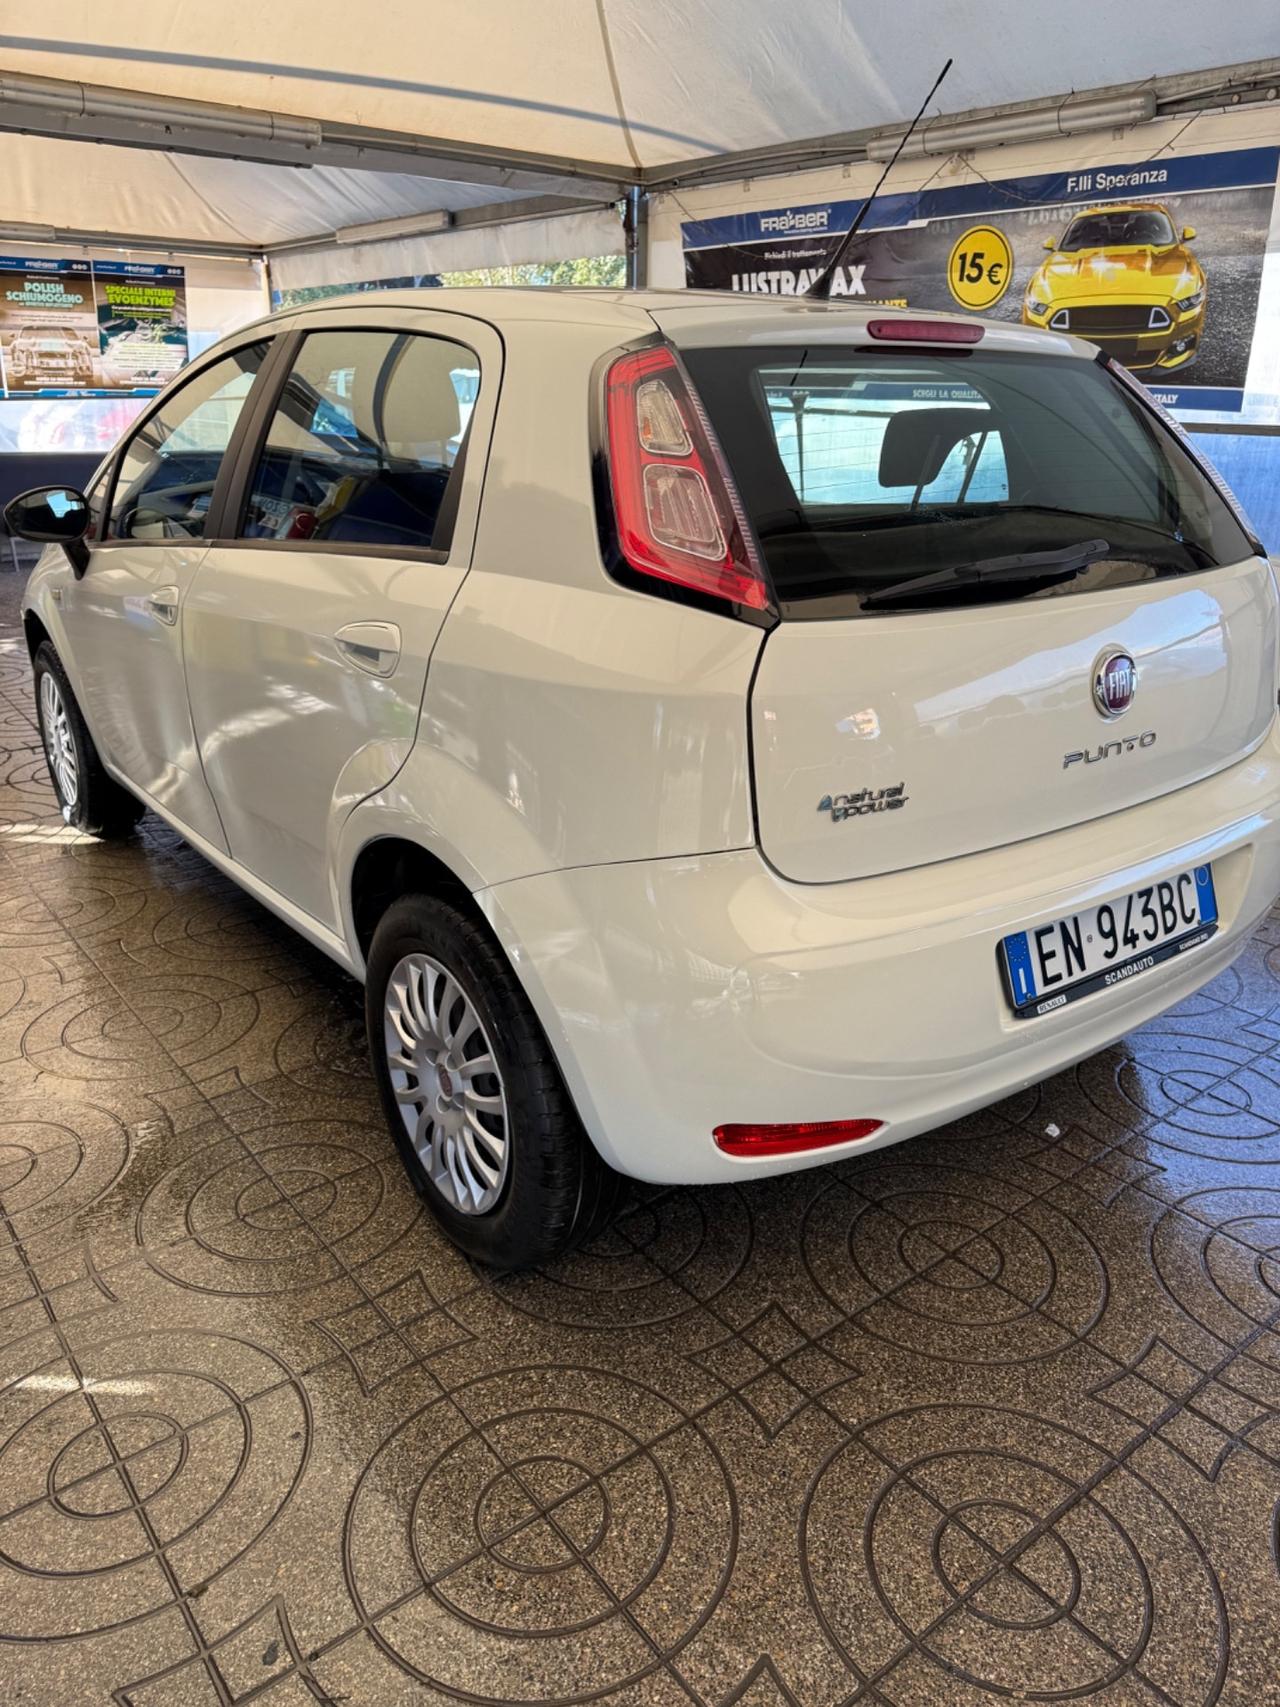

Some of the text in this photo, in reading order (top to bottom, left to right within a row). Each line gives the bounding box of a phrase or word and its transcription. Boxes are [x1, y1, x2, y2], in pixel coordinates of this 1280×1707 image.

[1095, 169, 1167, 192] Speranza
[5, 290, 84, 305] SCHIUMOGENO
[24, 281, 65, 294] POLISH
[105, 284, 144, 295] SPECIALE
[108, 293, 175, 306] EVOENZYMES
[938, 389, 948, 398] LA
[1109, 668, 1132, 701] FIAT
[1062, 730, 1157, 771] PUNTO
[833, 781, 905, 806] natural
[1034, 915, 1087, 987] EN
[1096, 873, 1196, 960] 943BC
[1104, 955, 1155, 985] SCANDAUTO
